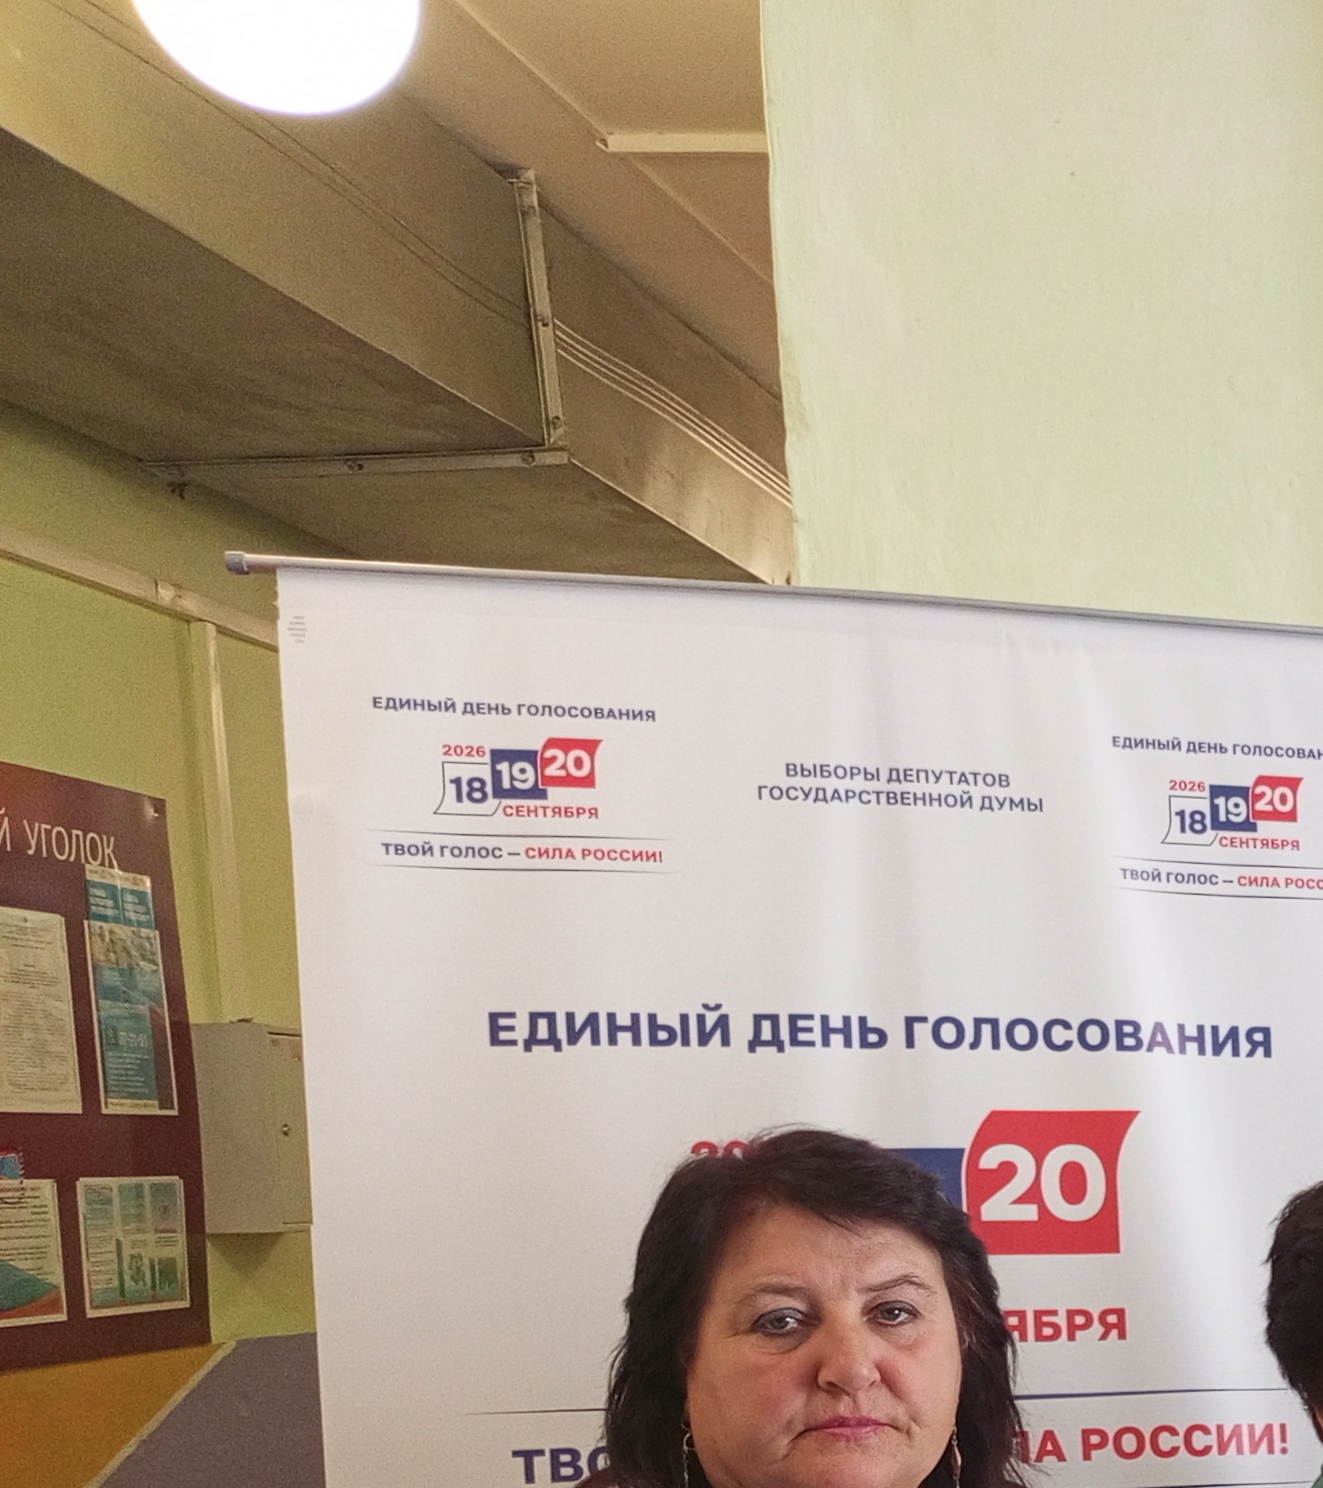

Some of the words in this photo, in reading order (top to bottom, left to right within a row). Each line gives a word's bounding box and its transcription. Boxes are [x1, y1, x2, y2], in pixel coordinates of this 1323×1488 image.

[372, 696, 457, 714] ЕДИНЫЙ
[461, 701, 512, 716] ДЕНЬ
[516, 703, 656, 723] ГОЛОСОВАНИЯ
[442, 744, 486, 760] 2026
[1112, 735, 1182, 752] ЕДИНЫЙ
[1185, 740, 1229, 755] ДЕНЬ
[450, 777, 488, 803] 18
[495, 761, 536, 790] 19
[543, 749, 592, 777] 20
[785, 762, 881, 782] ВЫБОРЫ
[886, 767, 1011, 788] ДЕПУТАТОВ
[1169, 779, 1206, 793] 2026
[502, 805, 599, 819] СЕНТЯБРЯ
[757, 785, 973, 809] ГОСУДАРСТВЕННОЙ
[979, 795, 1044, 813] ДУМЫ
[1174, 808, 1208, 836] 18
[1213, 793, 1249, 824] 19
[1253, 784, 1295, 814] 20
[23, 819, 119, 871] УГОЛОК
[380, 840, 434, 858] ТВОЙ
[439, 845, 503, 860] ГОЛОС
[524, 846, 576, 860] СИЛА
[581, 848, 663, 863] РОССИИ!
[1218, 835, 1300, 851] СЕНТЯБРЯ
[1120, 867, 1162, 883] ТВОЙ
[1165, 871, 1219, 886] ГОЛОС
[1237, 875, 1281, 888] СИЛА
[488, 1003, 731, 1053] ЕДИНЫЙ
[747, 1013, 888, 1054] ДЕНЬ
[904, 1015, 1272, 1058] ГОЛОСОВАНИЯ
[977, 1144, 1107, 1223] 20
[1081, 1423, 1289, 1461] РОССИИ!
